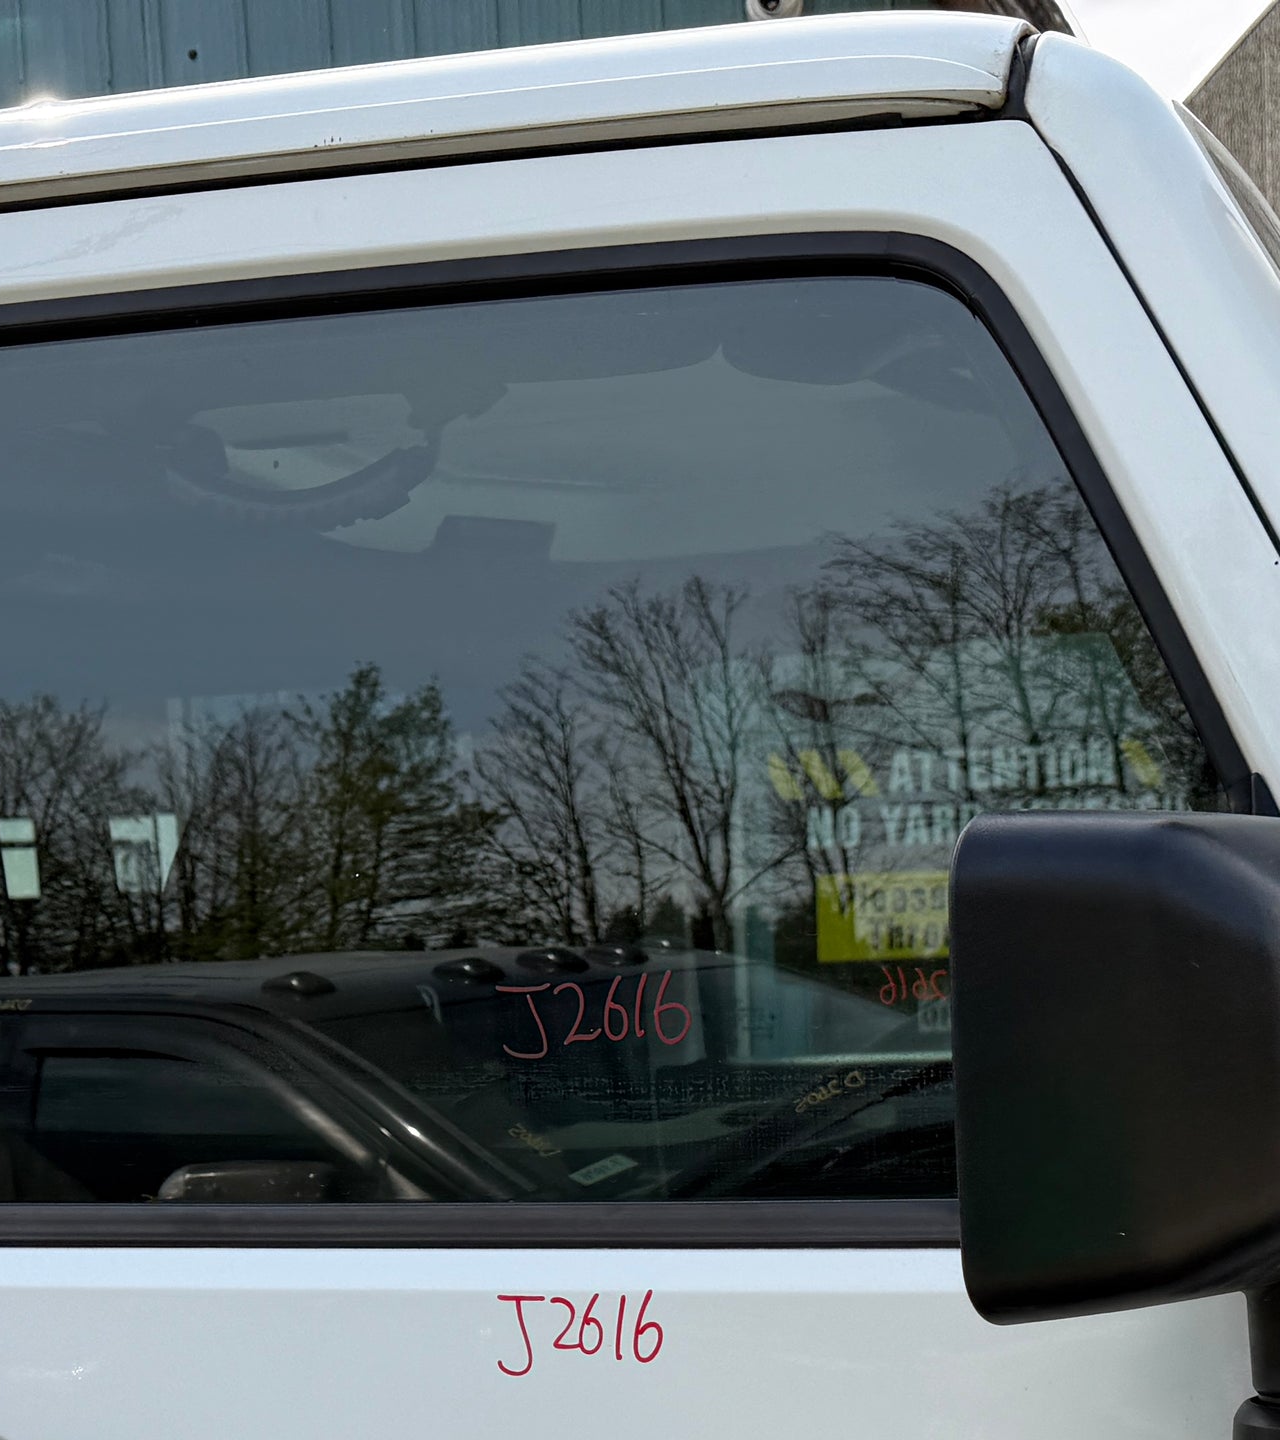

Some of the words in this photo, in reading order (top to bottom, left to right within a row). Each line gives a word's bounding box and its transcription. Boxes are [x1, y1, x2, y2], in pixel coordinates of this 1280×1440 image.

[888, 738, 1117, 793] ATTENTION
[806, 805, 861, 850] NO
[496, 970, 691, 1059] J2616
[497, 1289, 664, 1377] J2616
